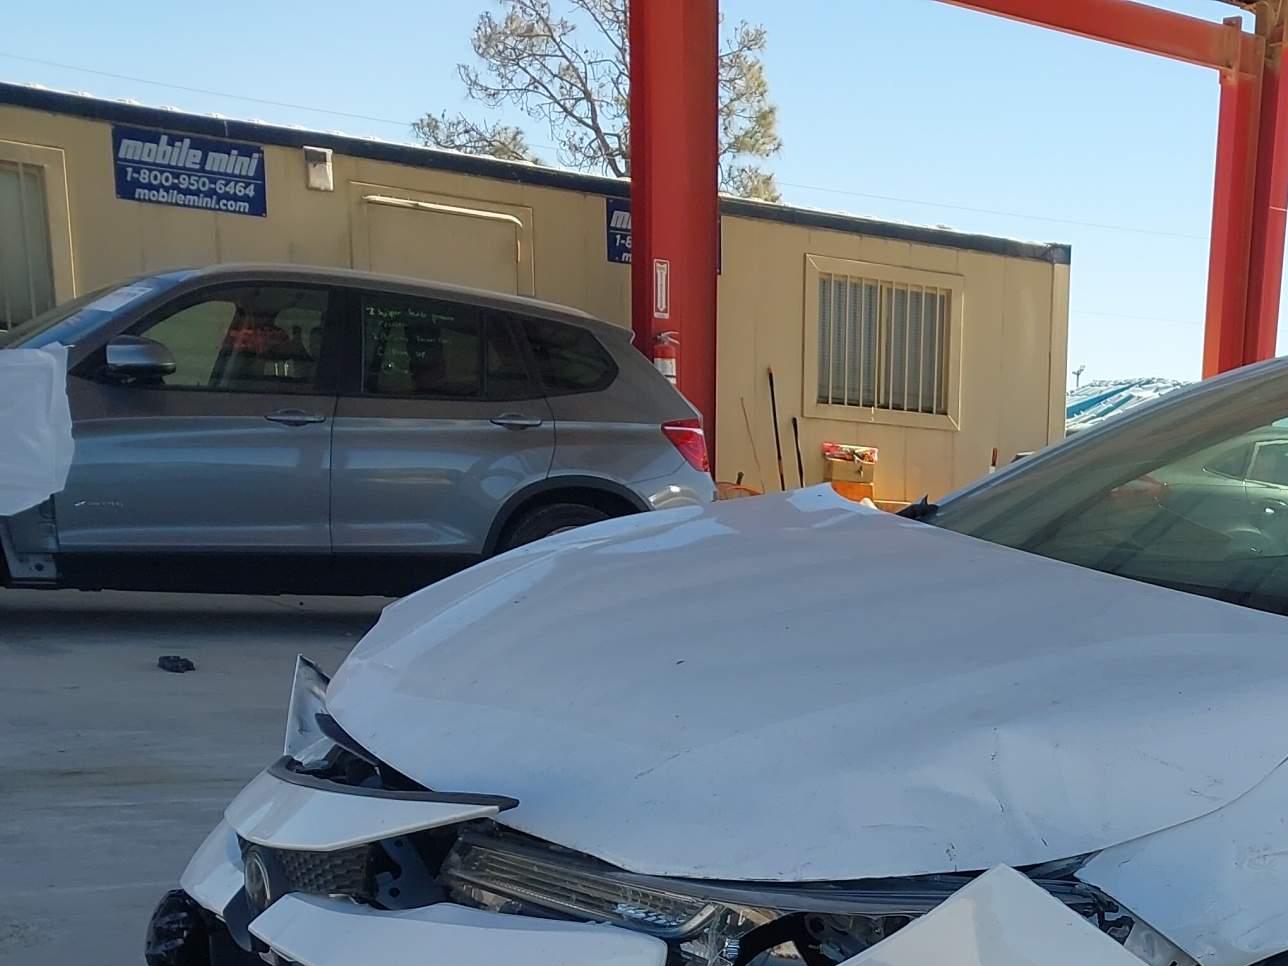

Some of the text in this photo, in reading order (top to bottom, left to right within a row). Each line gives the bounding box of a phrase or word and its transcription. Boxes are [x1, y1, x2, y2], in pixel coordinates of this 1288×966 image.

[118, 134, 260, 177] mobile mini
[125, 167, 256, 198] 1-800-950-6464
[134, 188, 250, 213] mobilemini.com
